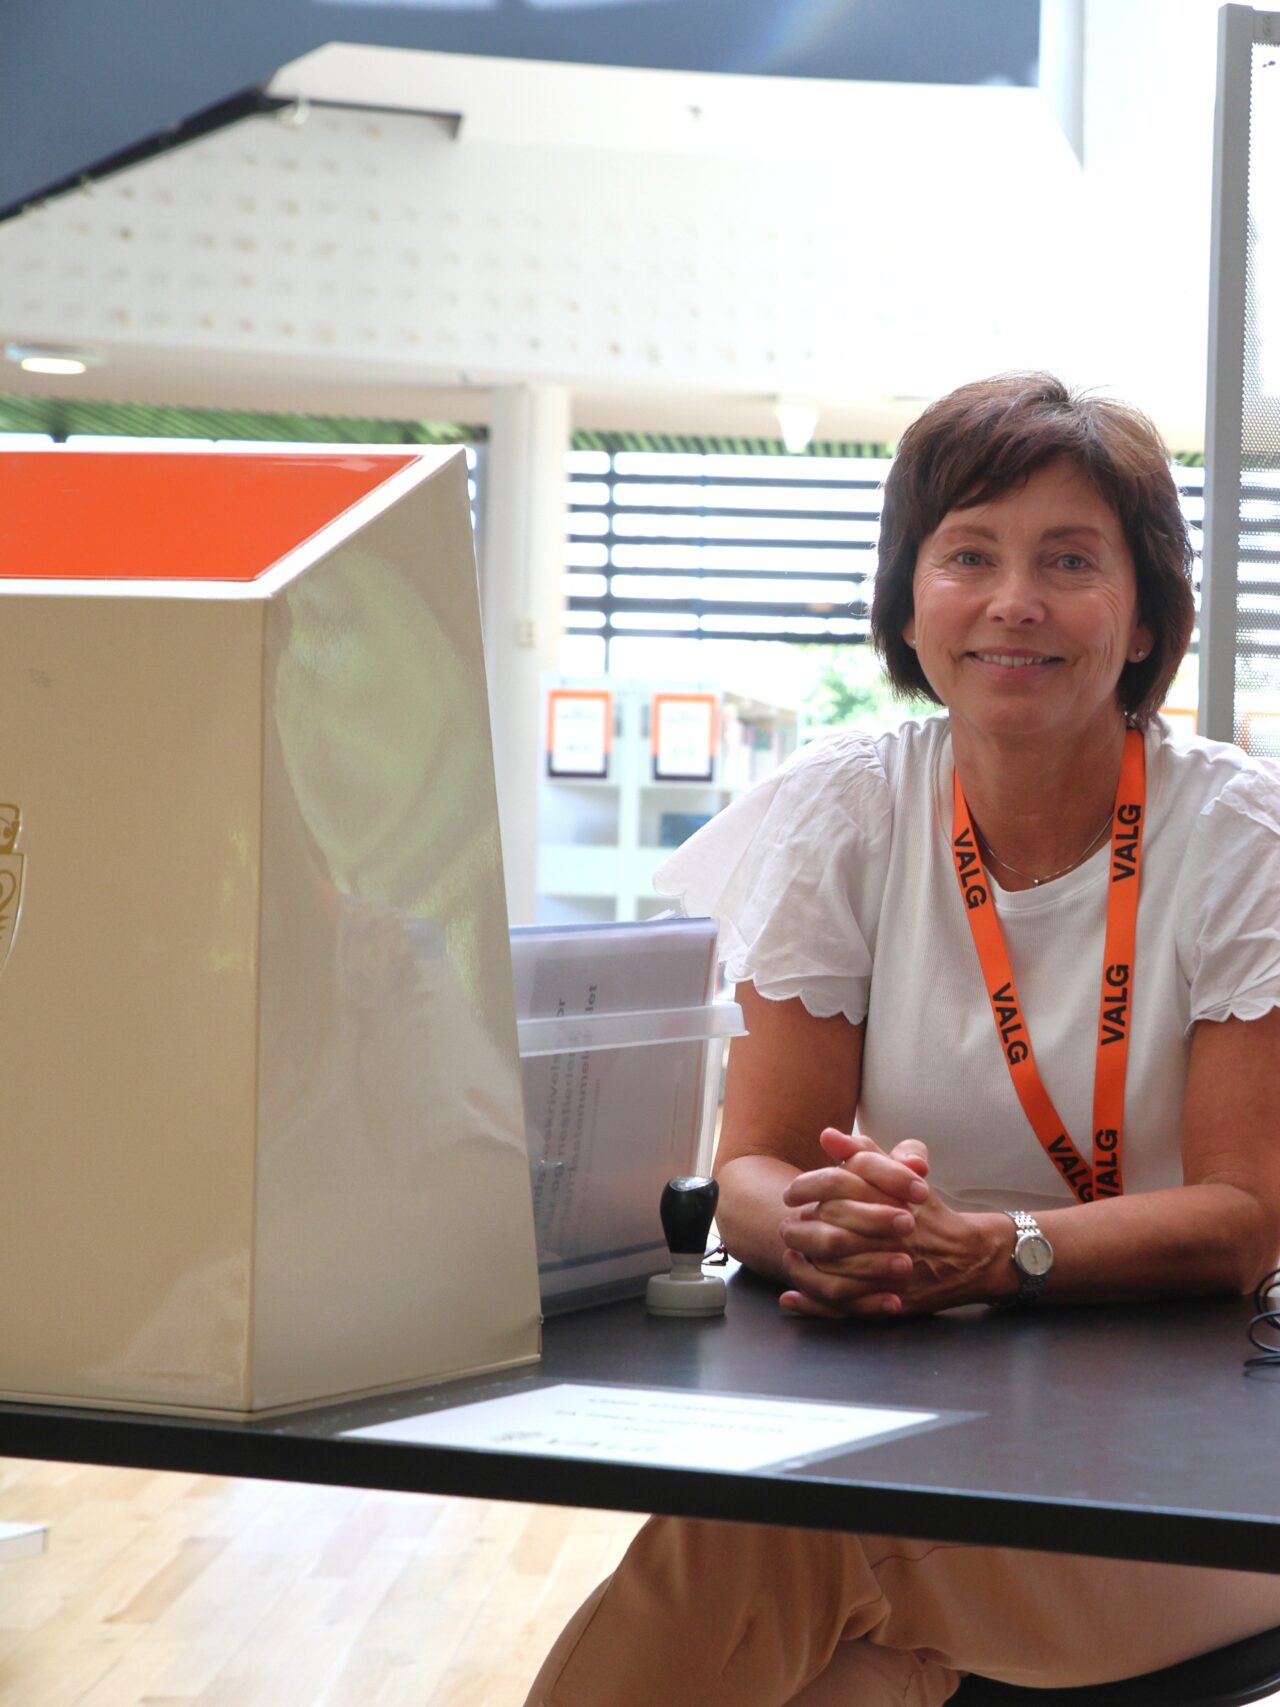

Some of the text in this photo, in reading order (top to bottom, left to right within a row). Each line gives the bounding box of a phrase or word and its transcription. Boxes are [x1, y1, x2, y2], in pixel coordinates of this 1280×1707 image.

[954, 828, 987, 909] VALG
[1113, 804, 1141, 882] VALG
[993, 982, 1028, 1065] VALG
[1101, 964, 1129, 1045] VALG
